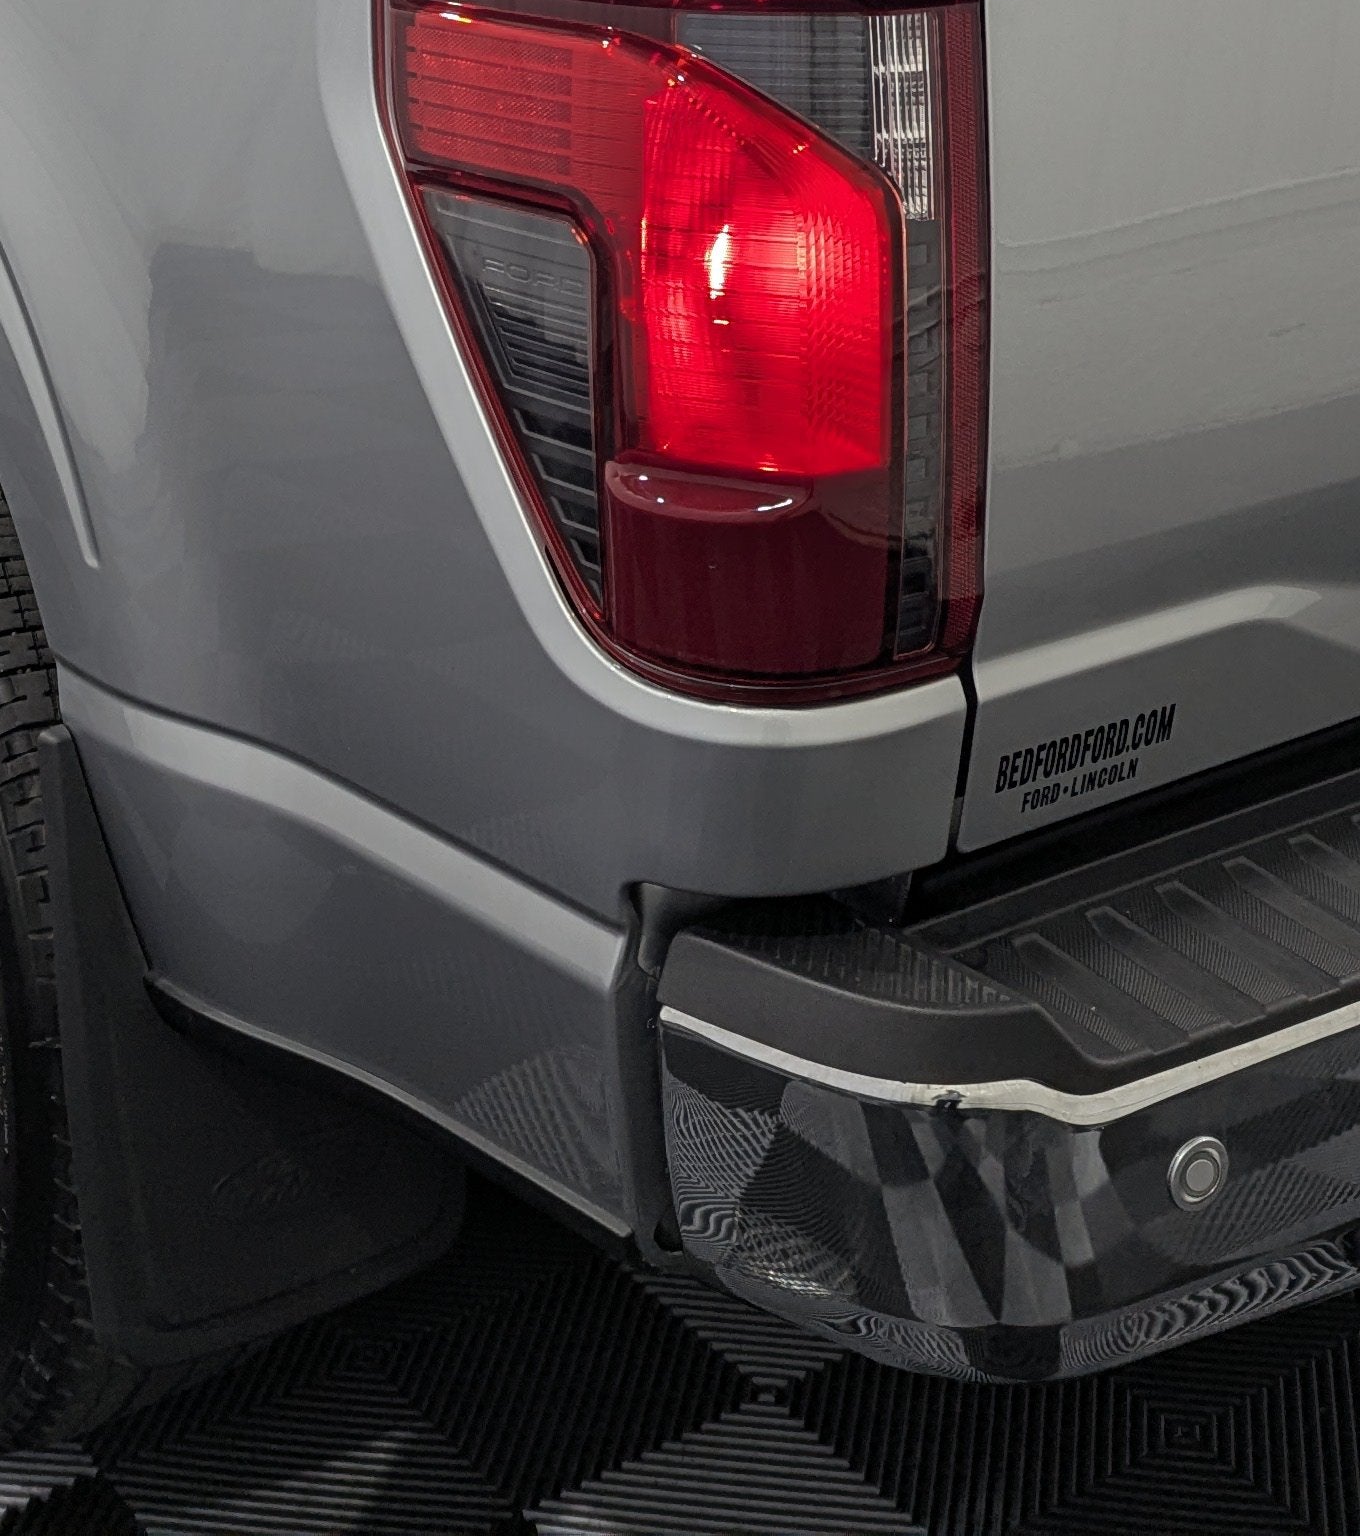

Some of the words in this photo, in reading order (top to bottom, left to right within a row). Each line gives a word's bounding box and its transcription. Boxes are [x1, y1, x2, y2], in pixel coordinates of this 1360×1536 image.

[994, 703, 1177, 794] BEDFORDFORD.COM
[1020, 784, 1061, 813] FORD
[1070, 757, 1139, 798] LINCOLN
